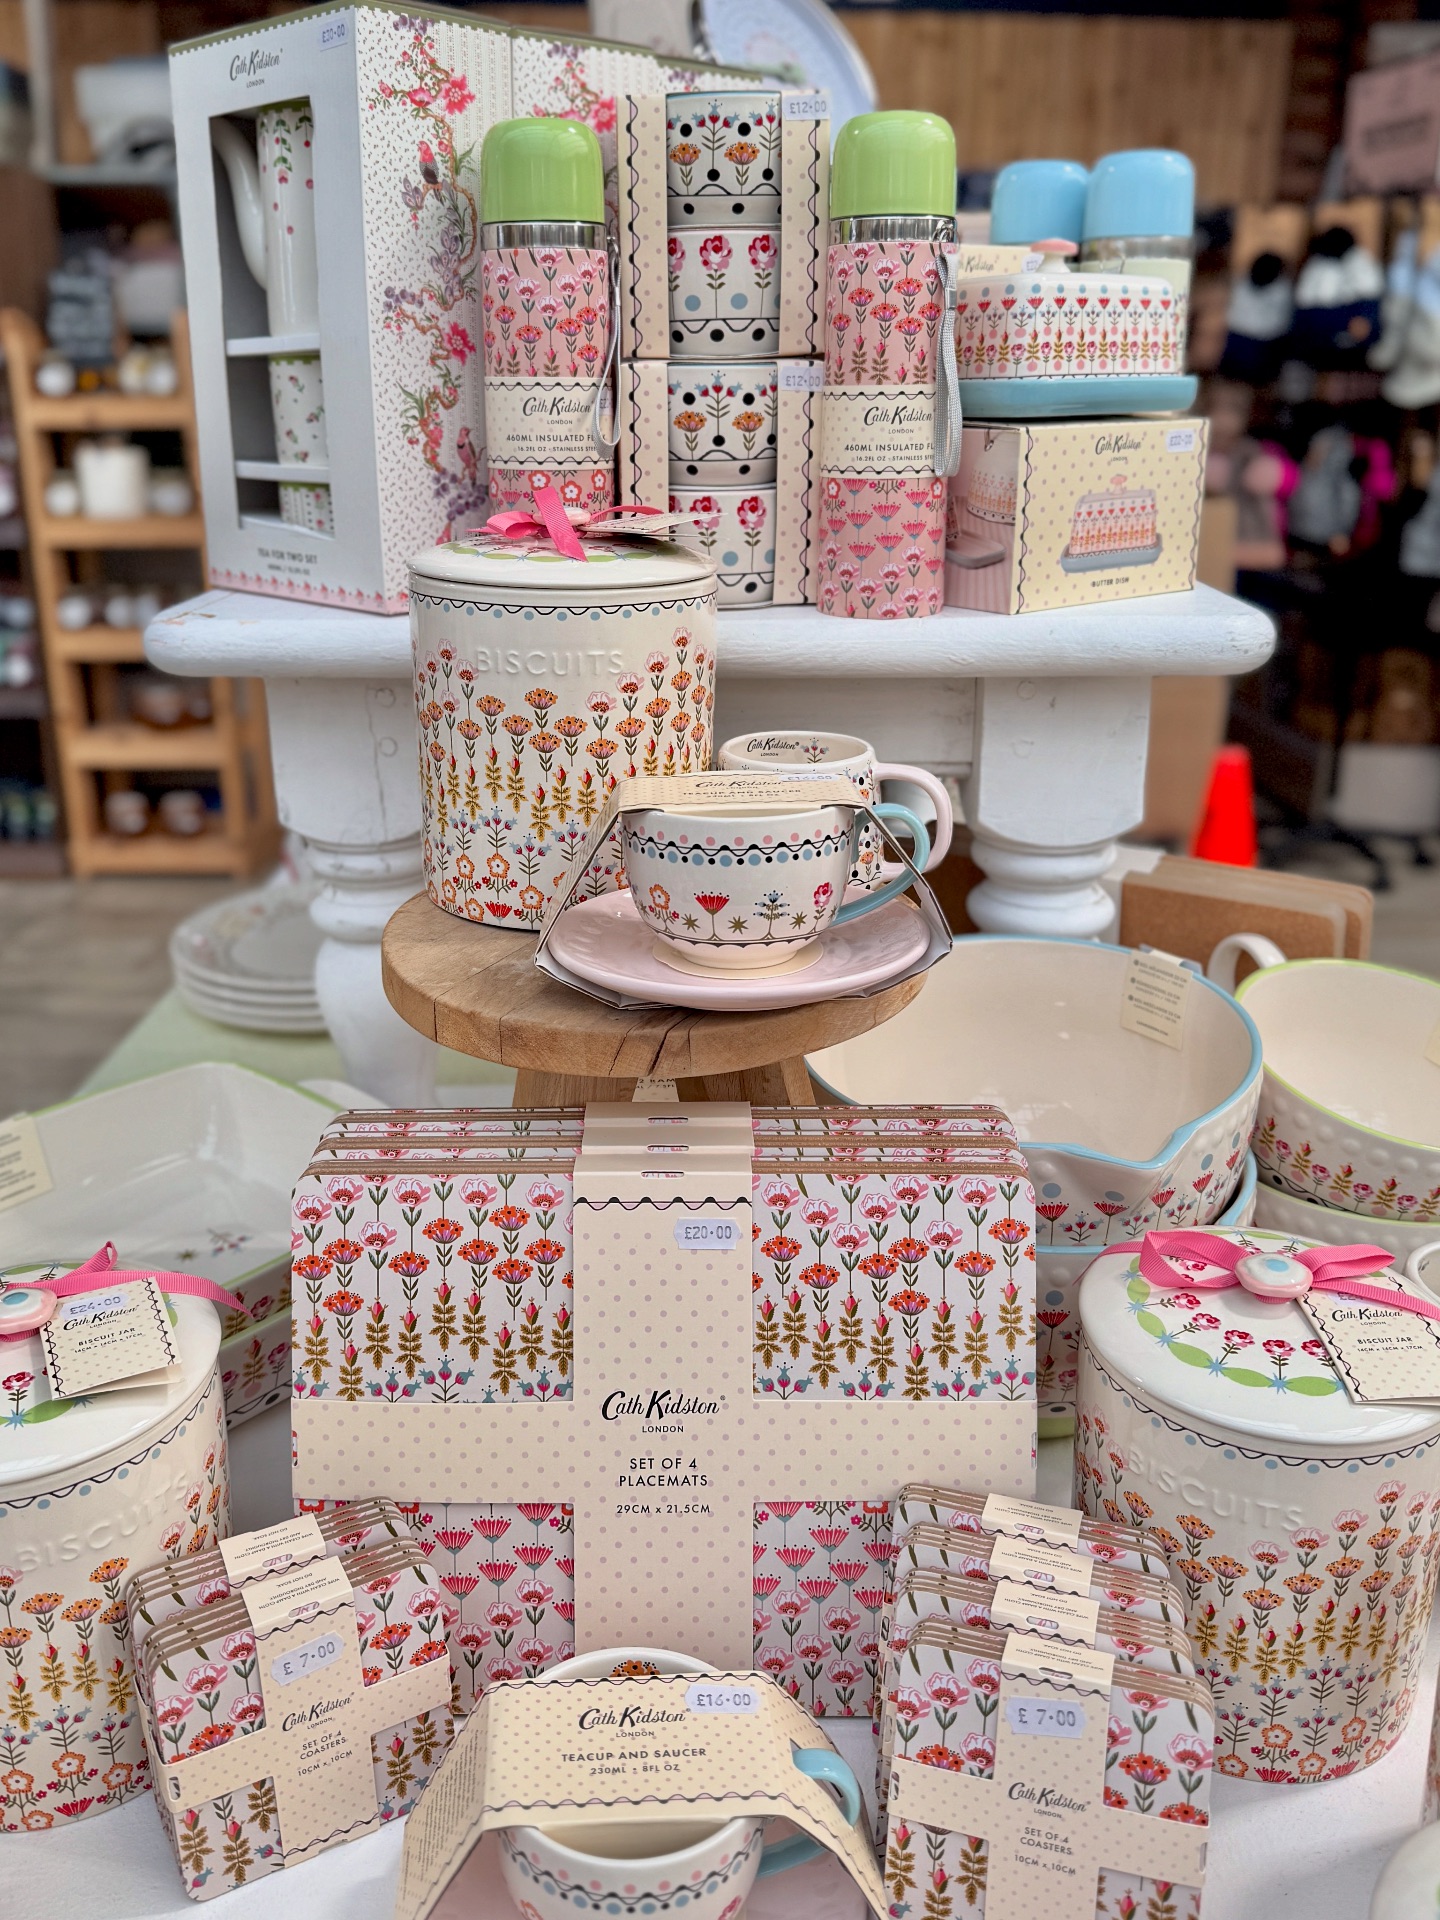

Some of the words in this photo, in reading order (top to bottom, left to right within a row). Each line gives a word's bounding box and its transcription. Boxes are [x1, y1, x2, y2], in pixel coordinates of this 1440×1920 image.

[229, 55, 248, 81] Cath
[247, 49, 280, 76] Kidston
[246, 79, 265, 88] LONDON
[522, 396, 548, 416] Cath
[549, 396, 591, 416] Kidston
[864, 406, 891, 426] Cath
[890, 405, 933, 425] Kidston
[506, 434, 532, 442] 460ML
[535, 434, 585, 442] INSULATED
[844, 444, 872, 452] 460ML
[875, 443, 924, 451] INSULATED
[1095, 436, 1112, 455] Cath
[1091, 579, 1113, 587] BUTTER
[476, 647, 623, 677] BISCUITS
[747, 738, 763, 753] Cath
[763, 738, 796, 751] Kidston
[63, 1318, 91, 1331] Cath
[91, 1307, 138, 1324] Kidston
[89, 1319, 117, 1329] LONDON
[1332, 1309, 1358, 1322] Cath
[1358, 1307, 1402, 1320] Kidston
[78, 1332, 115, 1346] BISCUIT
[118, 1327, 136, 1336] JAR
[601, 1390, 645, 1421] Cath
[645, 1389, 720, 1420] Kidston
[630, 1458, 655, 1470] SET
[661, 1458, 682, 1470] OF
[688, 1458, 697, 1469] 4
[619, 1475, 708, 1487] PLACEMATS
[1127, 1445, 1303, 1532] BISCUITS
[616, 1504, 650, 1514] 29CM
[666, 1504, 710, 1514] 21.5CM
[16, 1469, 189, 1572] BISCUITS
[282, 1711, 308, 1732] Cath
[307, 1696, 352, 1721] Kidston
[306, 1717, 333, 1730] LONDON
[578, 1708, 618, 1730] Cath
[618, 1705, 685, 1727] Kidston
[300, 1736, 346, 1760] COASTERS
[302, 1739, 317, 1751] SET
[320, 1732, 333, 1743] OF
[298, 1762, 320, 1776] 10CM
[331, 1750, 352, 1762] 10CM
[561, 1752, 613, 1762] TEACUP
[618, 1751, 649, 1760] AND
[654, 1748, 707, 1758] SAUCER
[590, 1766, 626, 1775] 230ML
[664, 1763, 681, 1771] OZ
[1008, 1782, 1037, 1800] Cath
[1037, 1787, 1087, 1812] Kidston
[1033, 1808, 1062, 1819] LONDON
[1024, 1827, 1042, 1838] SET
[1045, 1831, 1059, 1841] OF
[1063, 1836, 1069, 1844] 4
[1020, 1837, 1073, 1855] COASTERS
[1015, 1854, 1039, 1867] 10CM
[1051, 1862, 1076, 1875] 10CM
